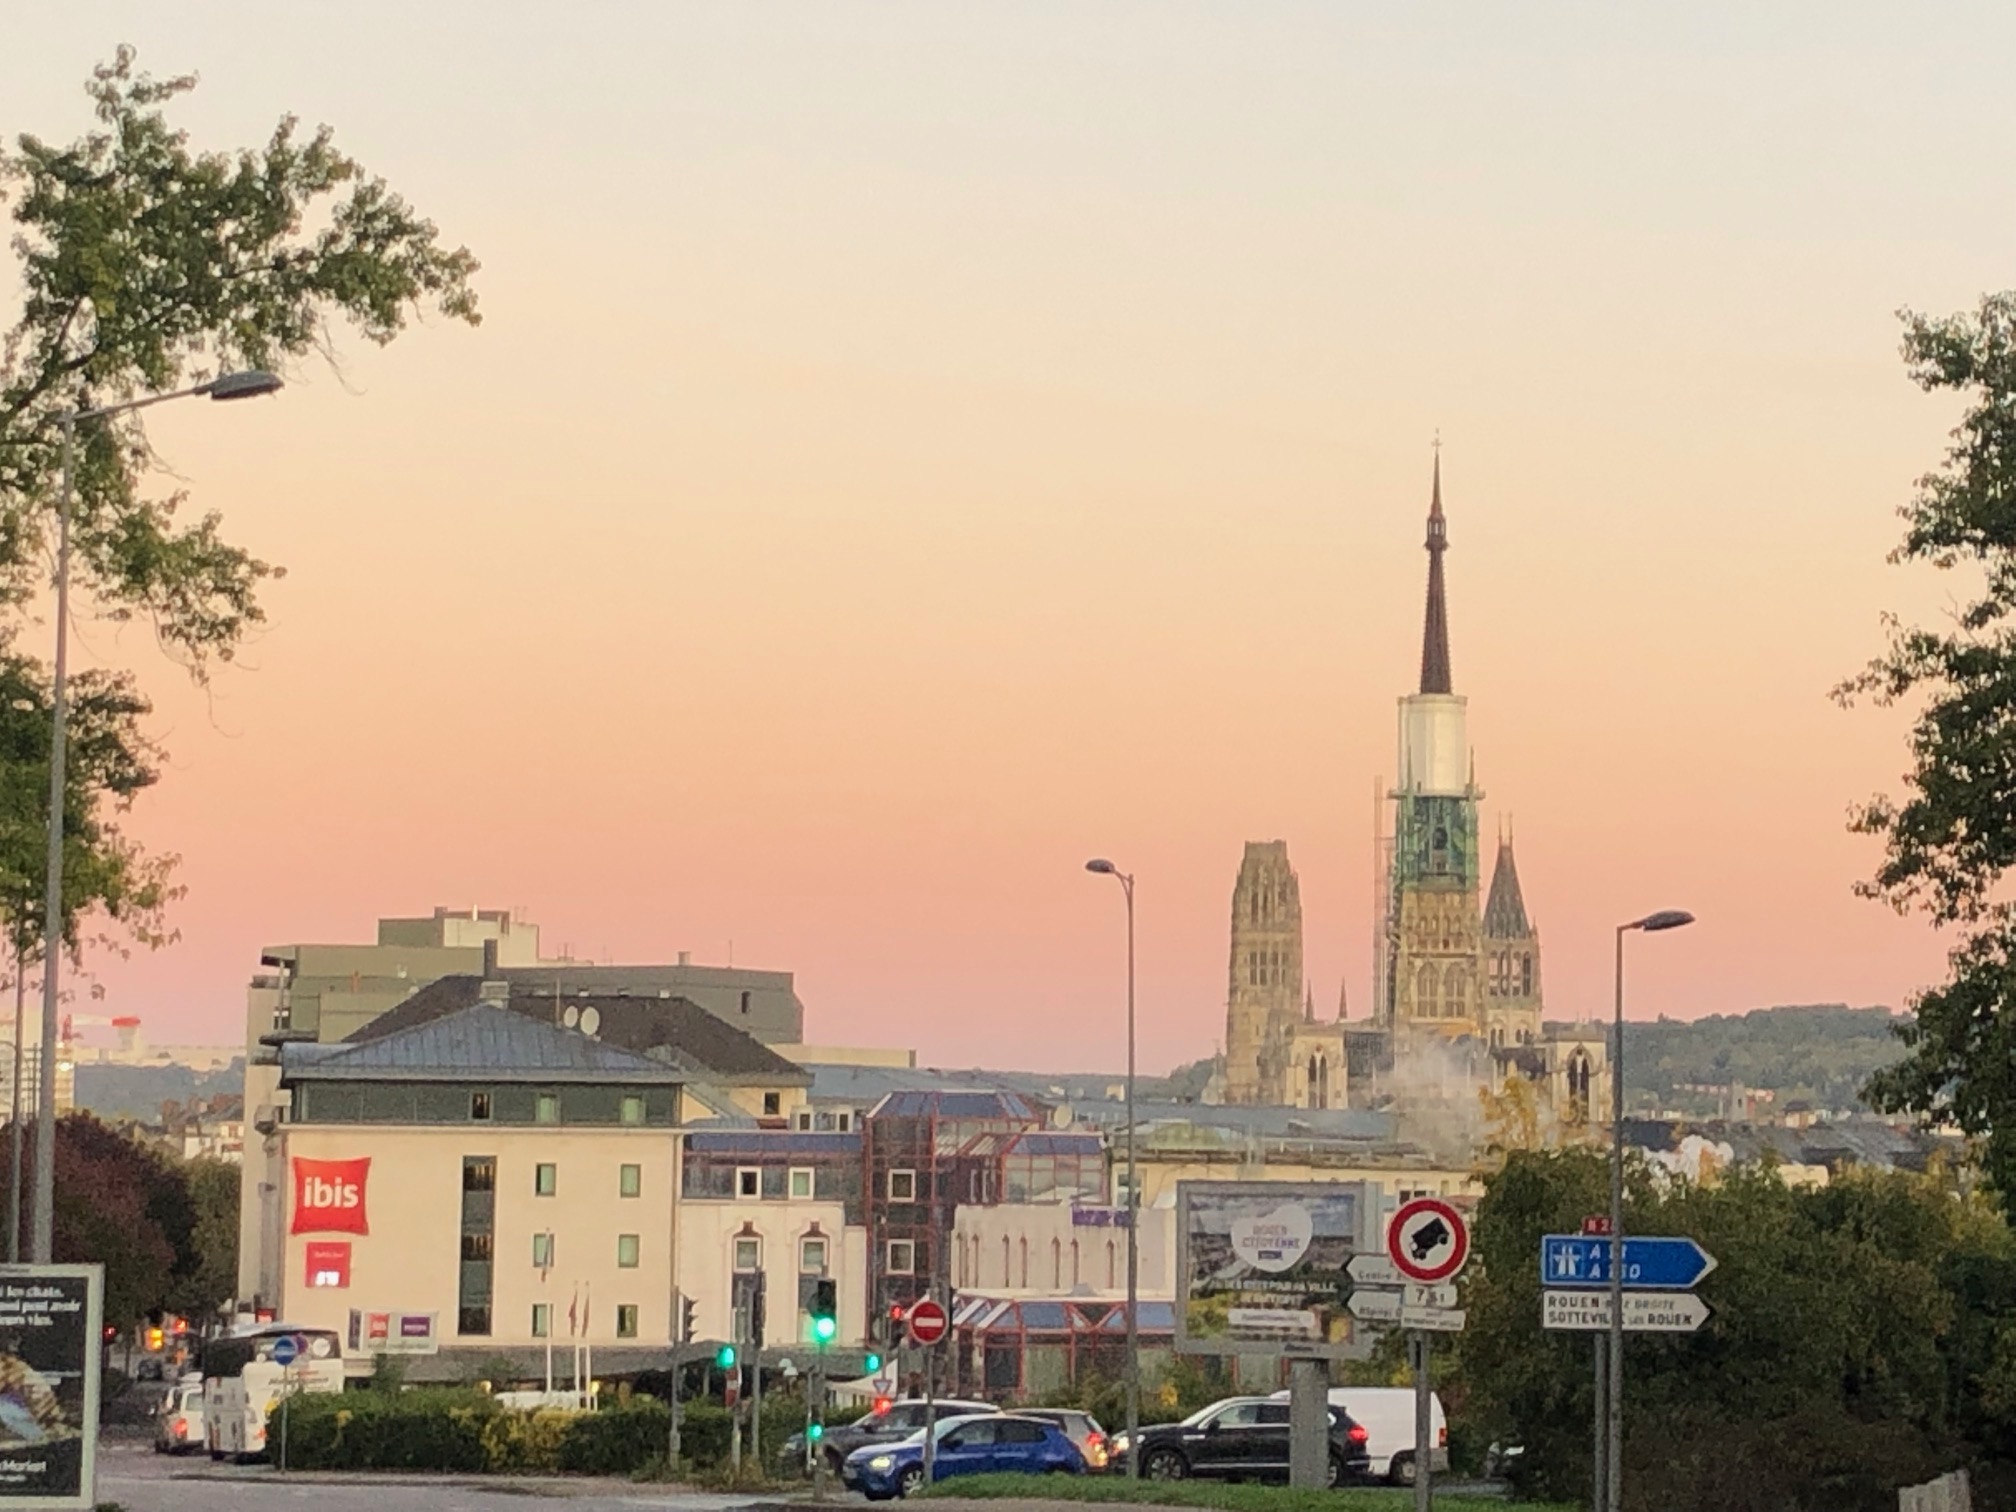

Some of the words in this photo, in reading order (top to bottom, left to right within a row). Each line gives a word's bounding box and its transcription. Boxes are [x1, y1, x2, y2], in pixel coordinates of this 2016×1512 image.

[303, 1176, 359, 1208] ibis
[1587, 1219, 1598, 1232] N
[1589, 1243, 1601, 1259] A
[1589, 1263, 1601, 1279] A
[1548, 1294, 1600, 1309] ROUEN
[1548, 1310, 1626, 1325] SOTTEVIL
[1647, 1312, 1693, 1327] ROUEN
